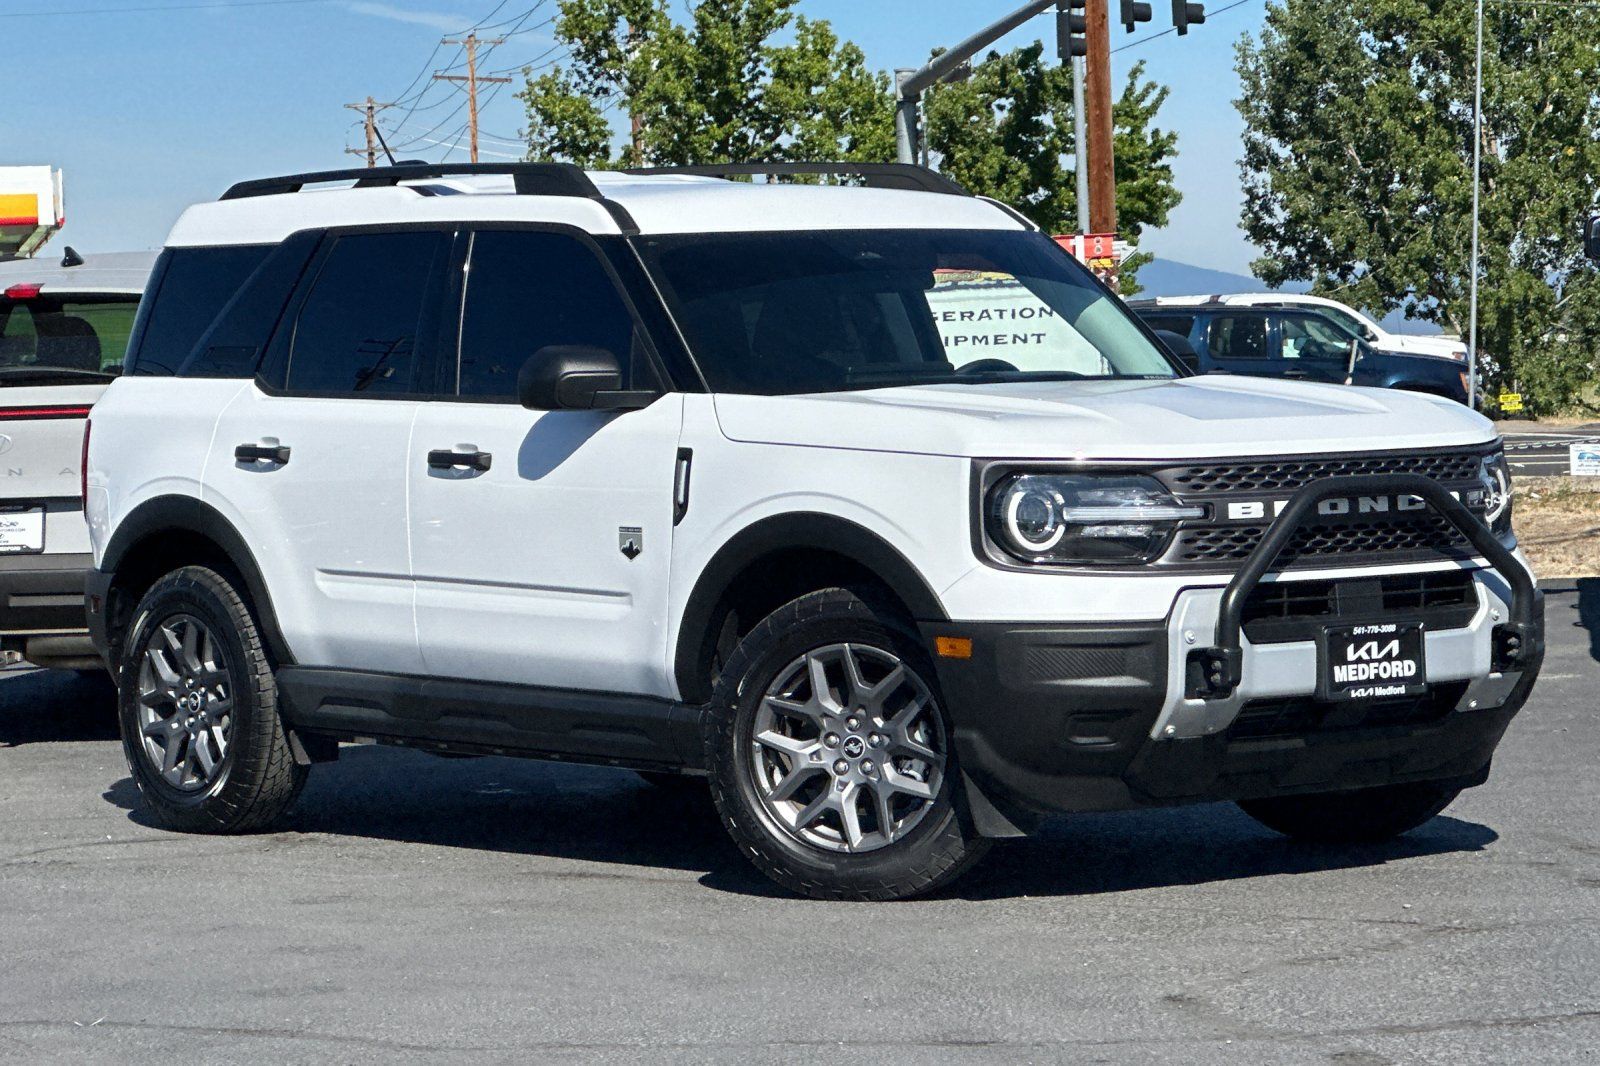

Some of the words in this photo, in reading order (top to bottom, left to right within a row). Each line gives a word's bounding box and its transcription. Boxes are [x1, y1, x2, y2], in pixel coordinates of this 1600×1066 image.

[1228, 491, 1460, 520] BONC
[1347, 640, 1399, 661] KIA
[1334, 660, 1416, 682] MEDFORD
[1375, 685, 1405, 695] Medford
